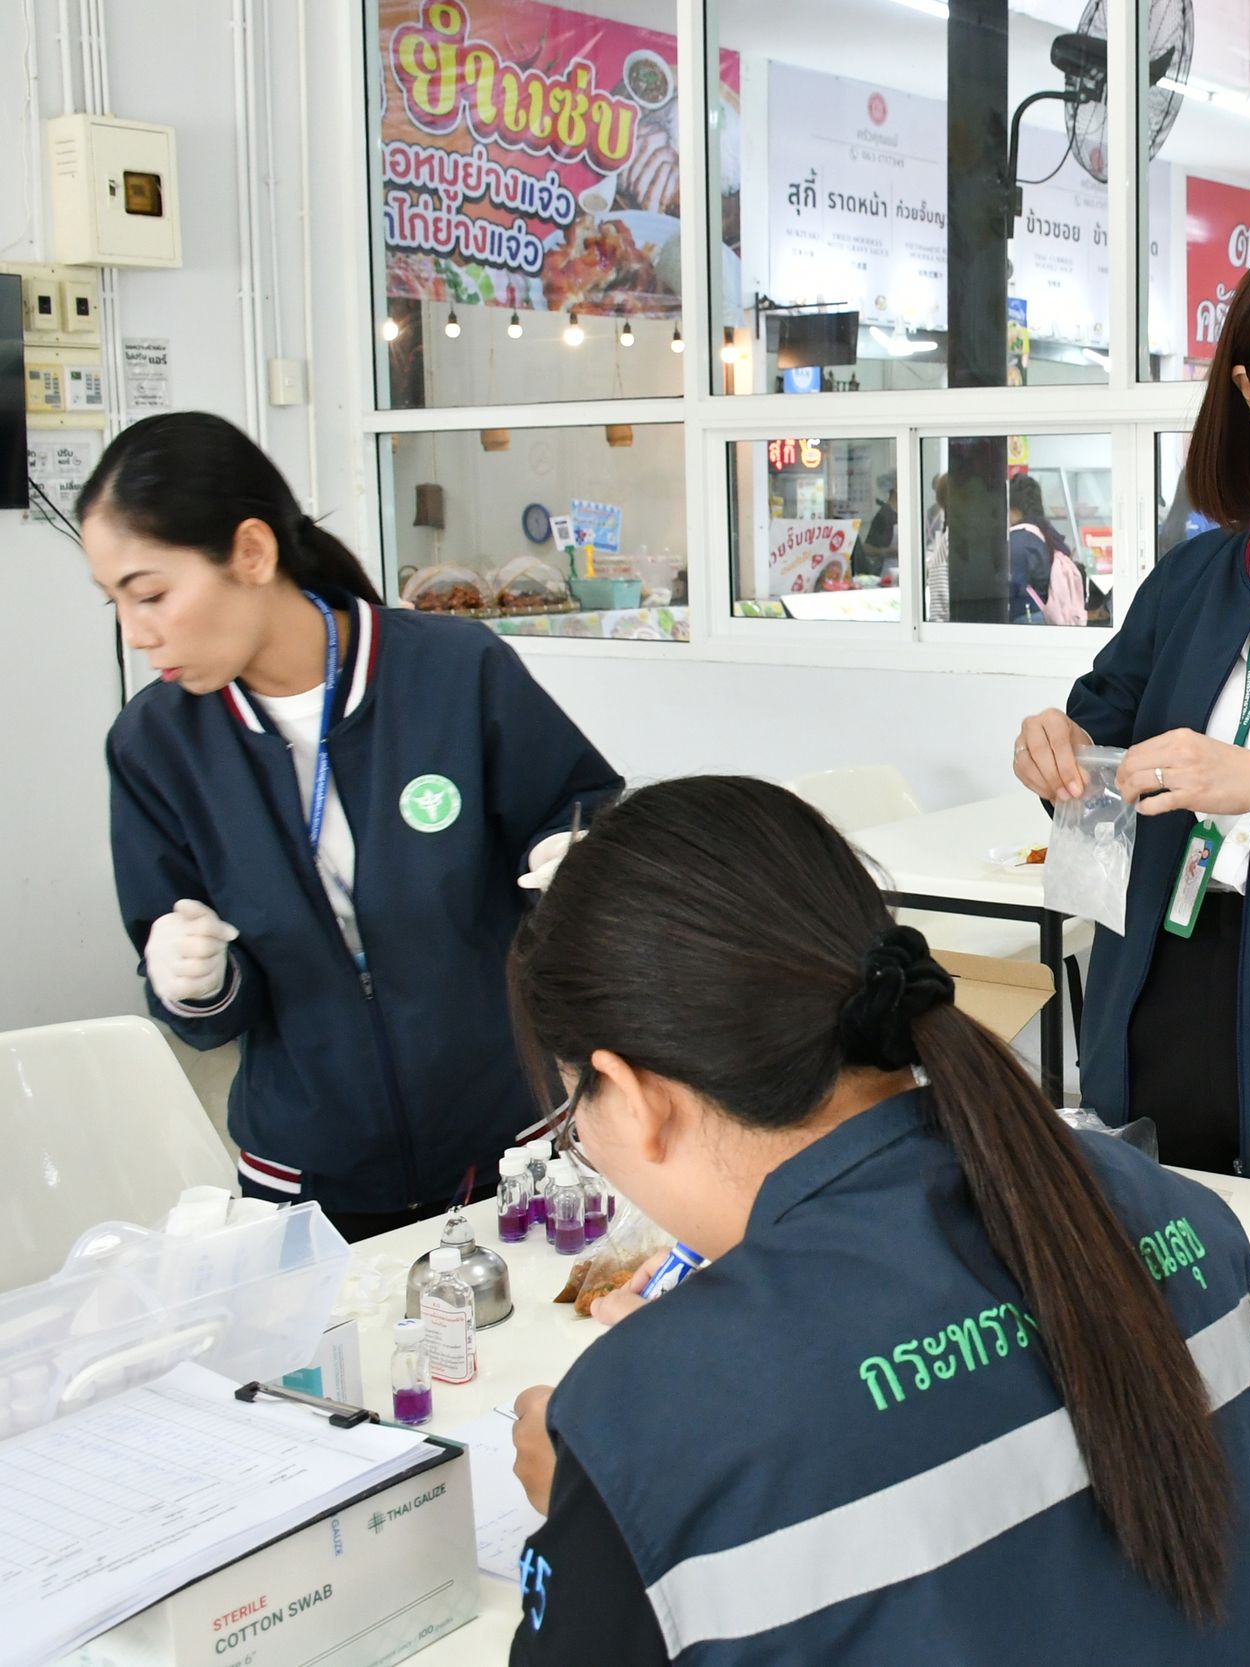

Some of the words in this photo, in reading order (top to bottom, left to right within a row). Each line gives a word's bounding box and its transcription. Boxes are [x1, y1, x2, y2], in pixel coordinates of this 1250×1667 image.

[788, 167, 818, 216] สุกี้
[828, 191, 888, 218] ราดหน้า
[1026, 208, 1081, 242] ข้าวซอย
[386, 1500, 413, 1522] THAI
[413, 1482, 447, 1509] GAUZE
[212, 1595, 268, 1632] STERILE
[215, 1608, 284, 1655] COTTON
[288, 1583, 333, 1618] SWAB
